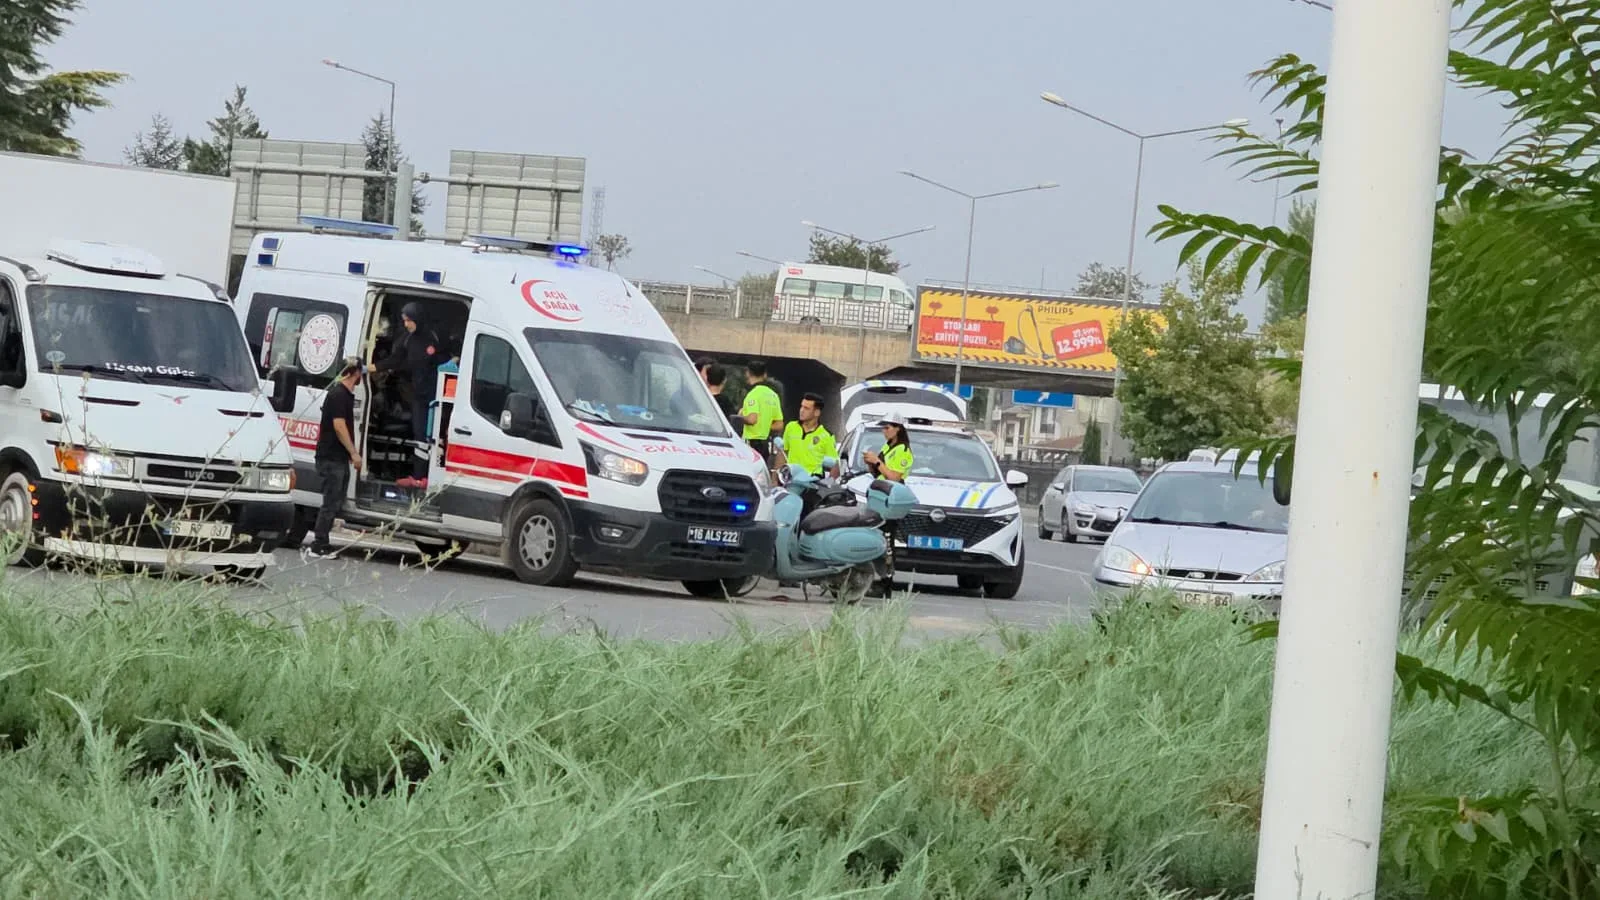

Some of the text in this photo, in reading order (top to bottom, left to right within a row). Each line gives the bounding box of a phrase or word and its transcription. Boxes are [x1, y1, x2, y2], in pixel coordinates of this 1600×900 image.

[543, 301, 582, 313] SAĞLIK
[1038, 305, 1074, 316] PHILIPS
[935, 330, 988, 345] ERİTİYRUZ!!!
[184, 470, 215, 480] IVECO
[693, 529, 737, 543] 16 ALS 222
